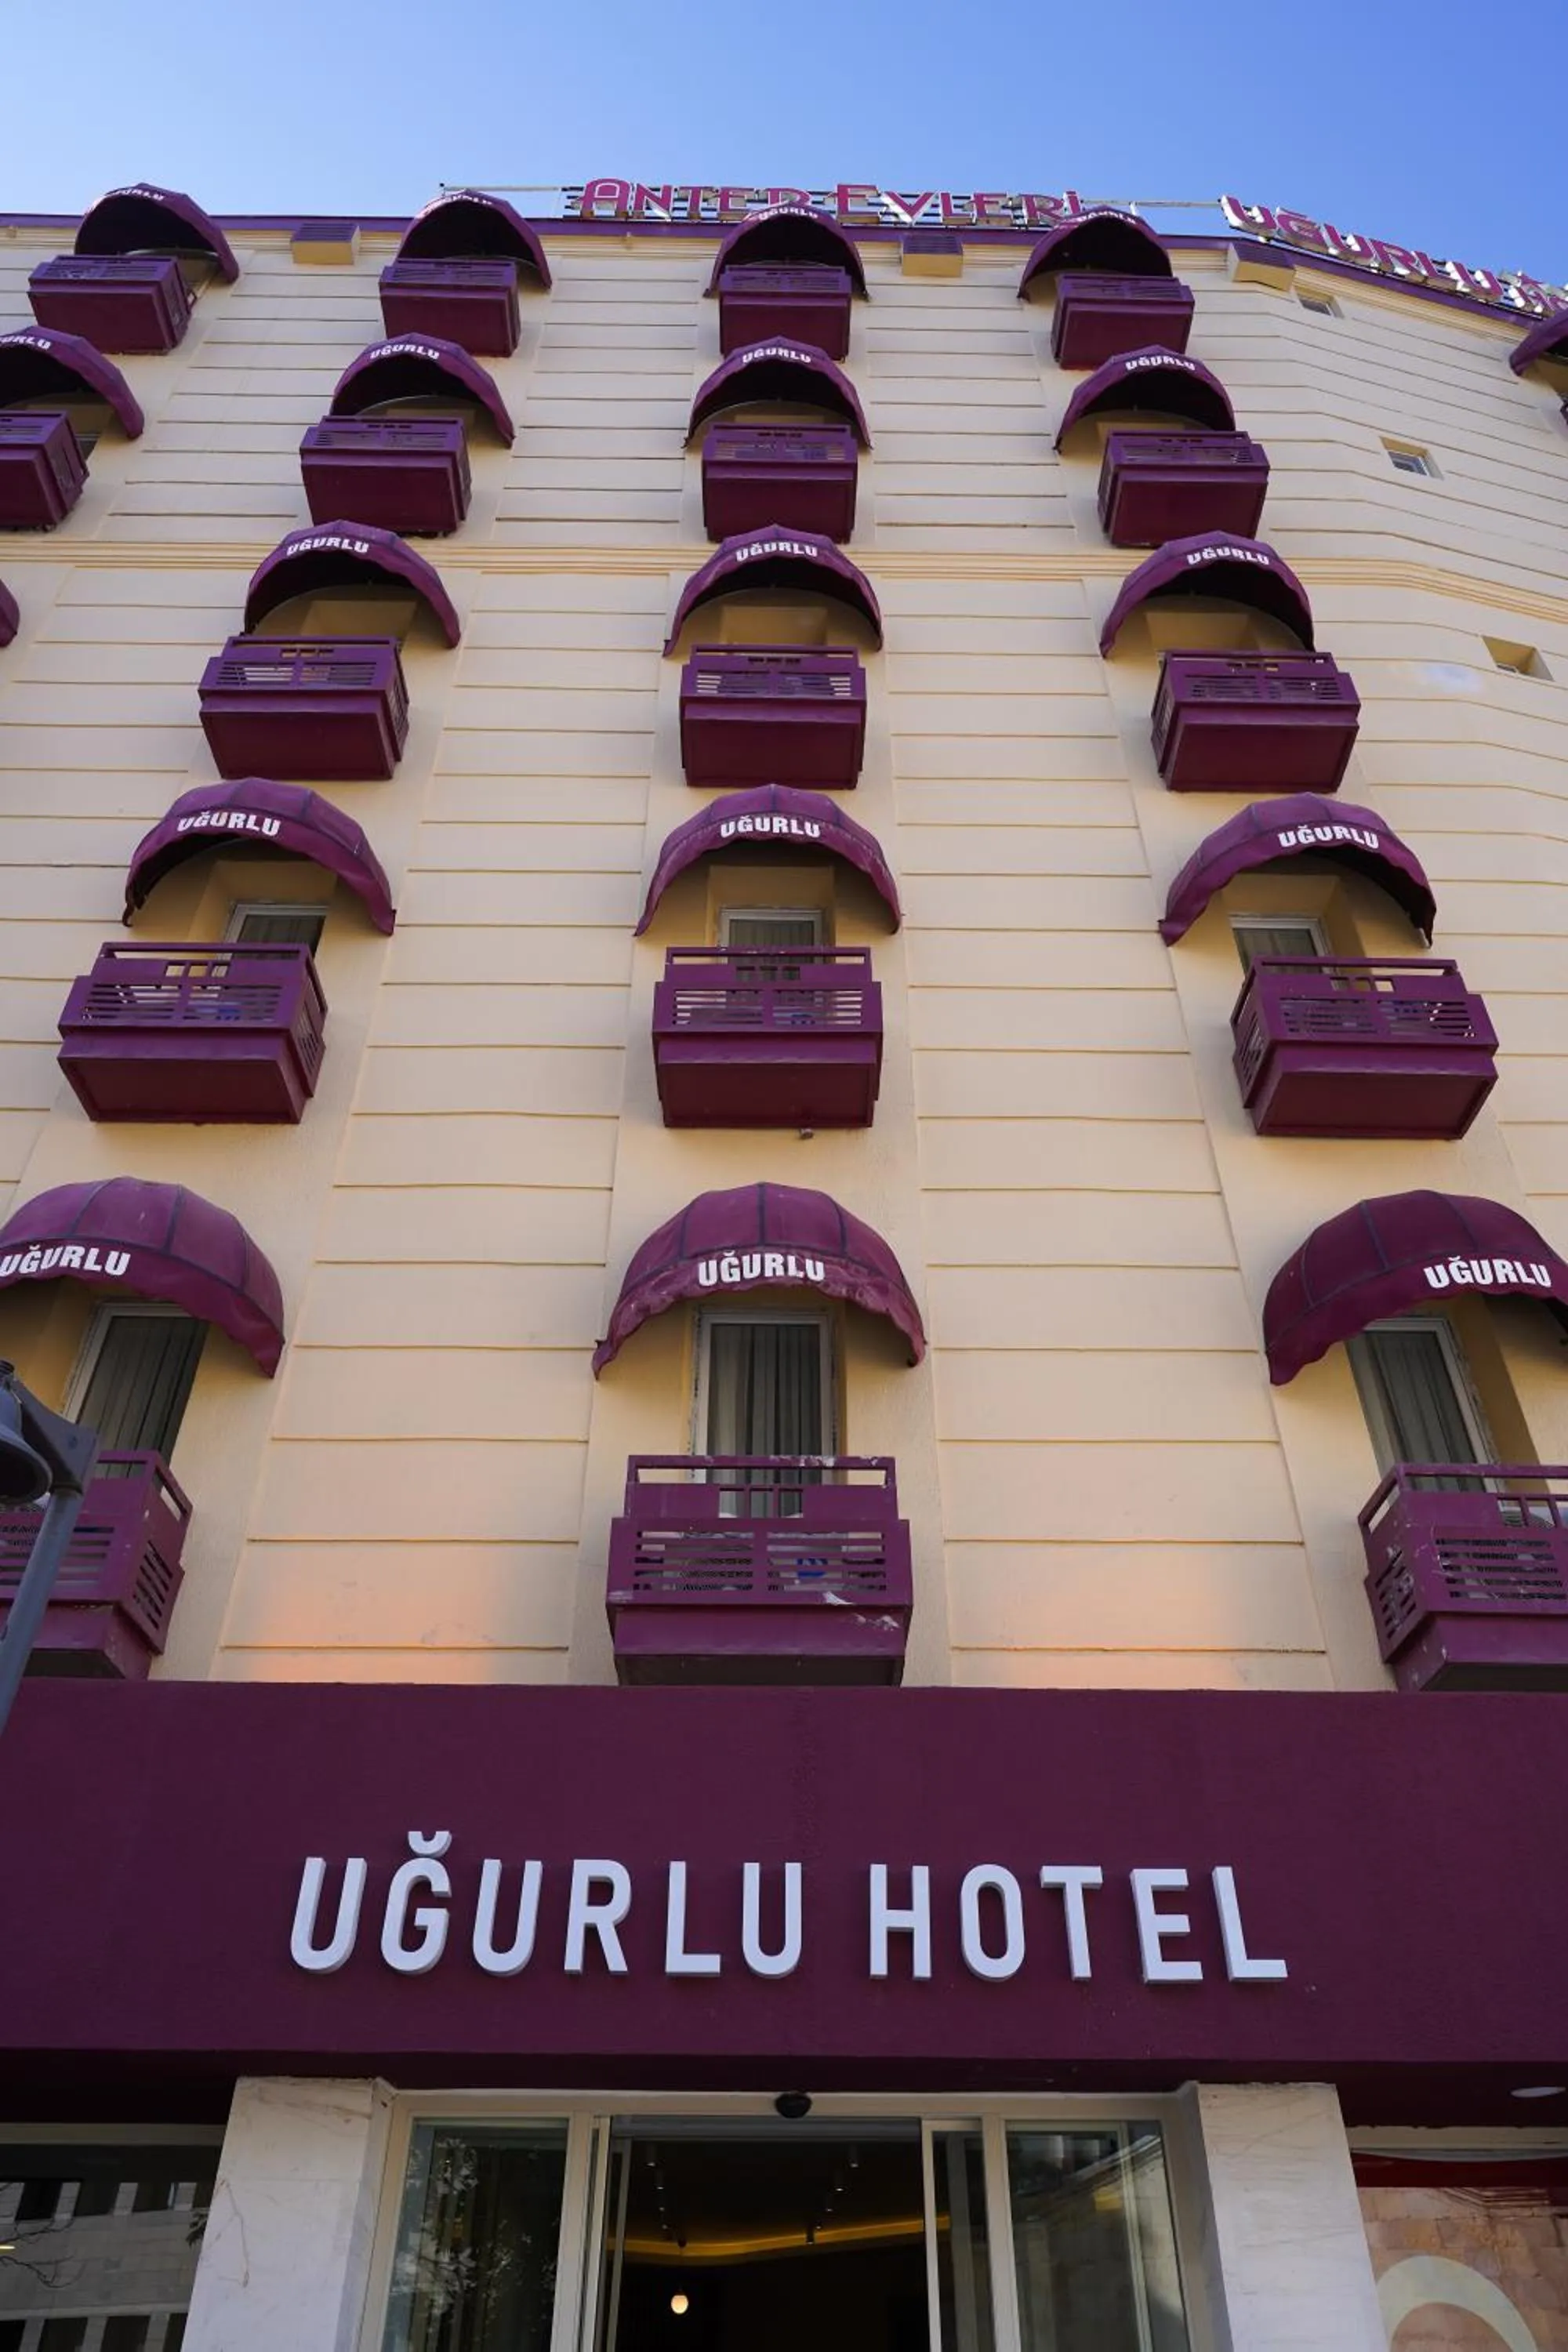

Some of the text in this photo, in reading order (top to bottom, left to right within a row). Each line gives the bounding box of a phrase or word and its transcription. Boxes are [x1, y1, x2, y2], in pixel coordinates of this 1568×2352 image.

[176, 811, 281, 837] UĞURLU
[720, 815, 821, 838] UĞURLU
[1277, 824, 1380, 849] UĞURLU
[0, 1244, 131, 1277] UĞURLU
[698, 1250, 826, 1287] UĞURLU
[1423, 1255, 1552, 1289] UĞURLU
[289, 1830, 1289, 1984] UĞURLU HOTEL
